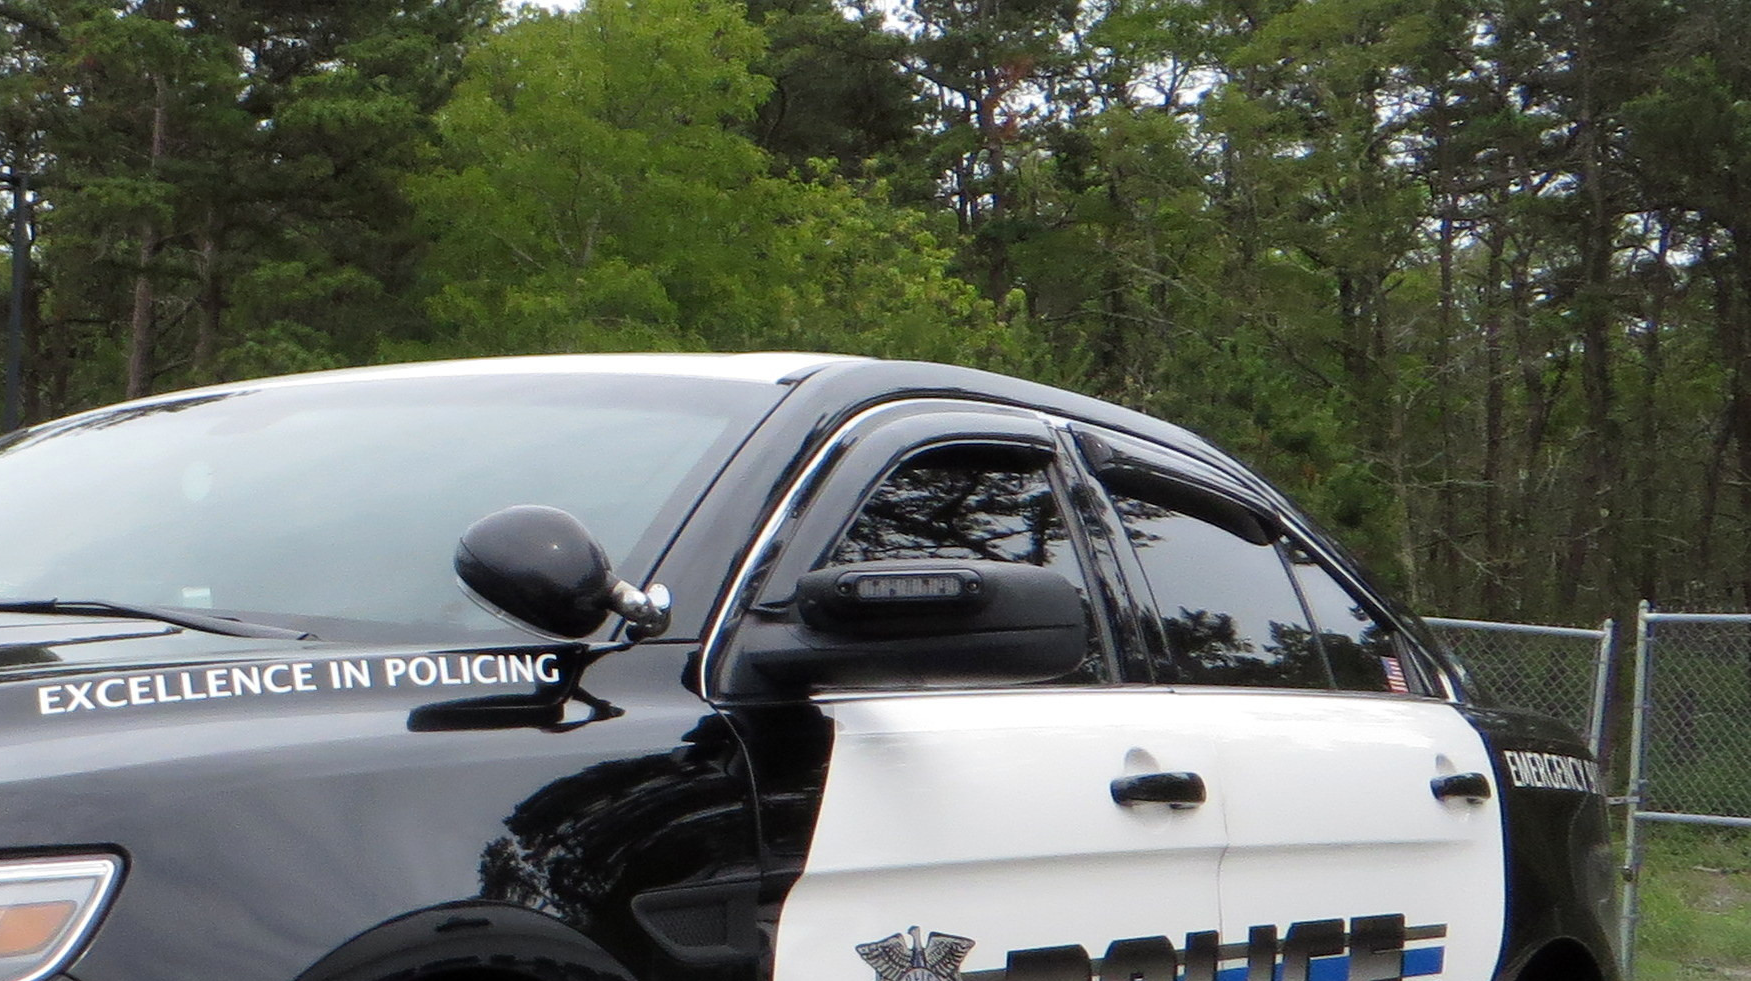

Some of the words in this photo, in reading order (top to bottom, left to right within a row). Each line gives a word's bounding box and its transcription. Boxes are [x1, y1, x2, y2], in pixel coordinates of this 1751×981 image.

[37, 662, 318, 715] EXCELLENCE
[329, 658, 373, 689] IN
[384, 653, 560, 687] POLICING
[1503, 750, 1590, 791] EMERGENCY
